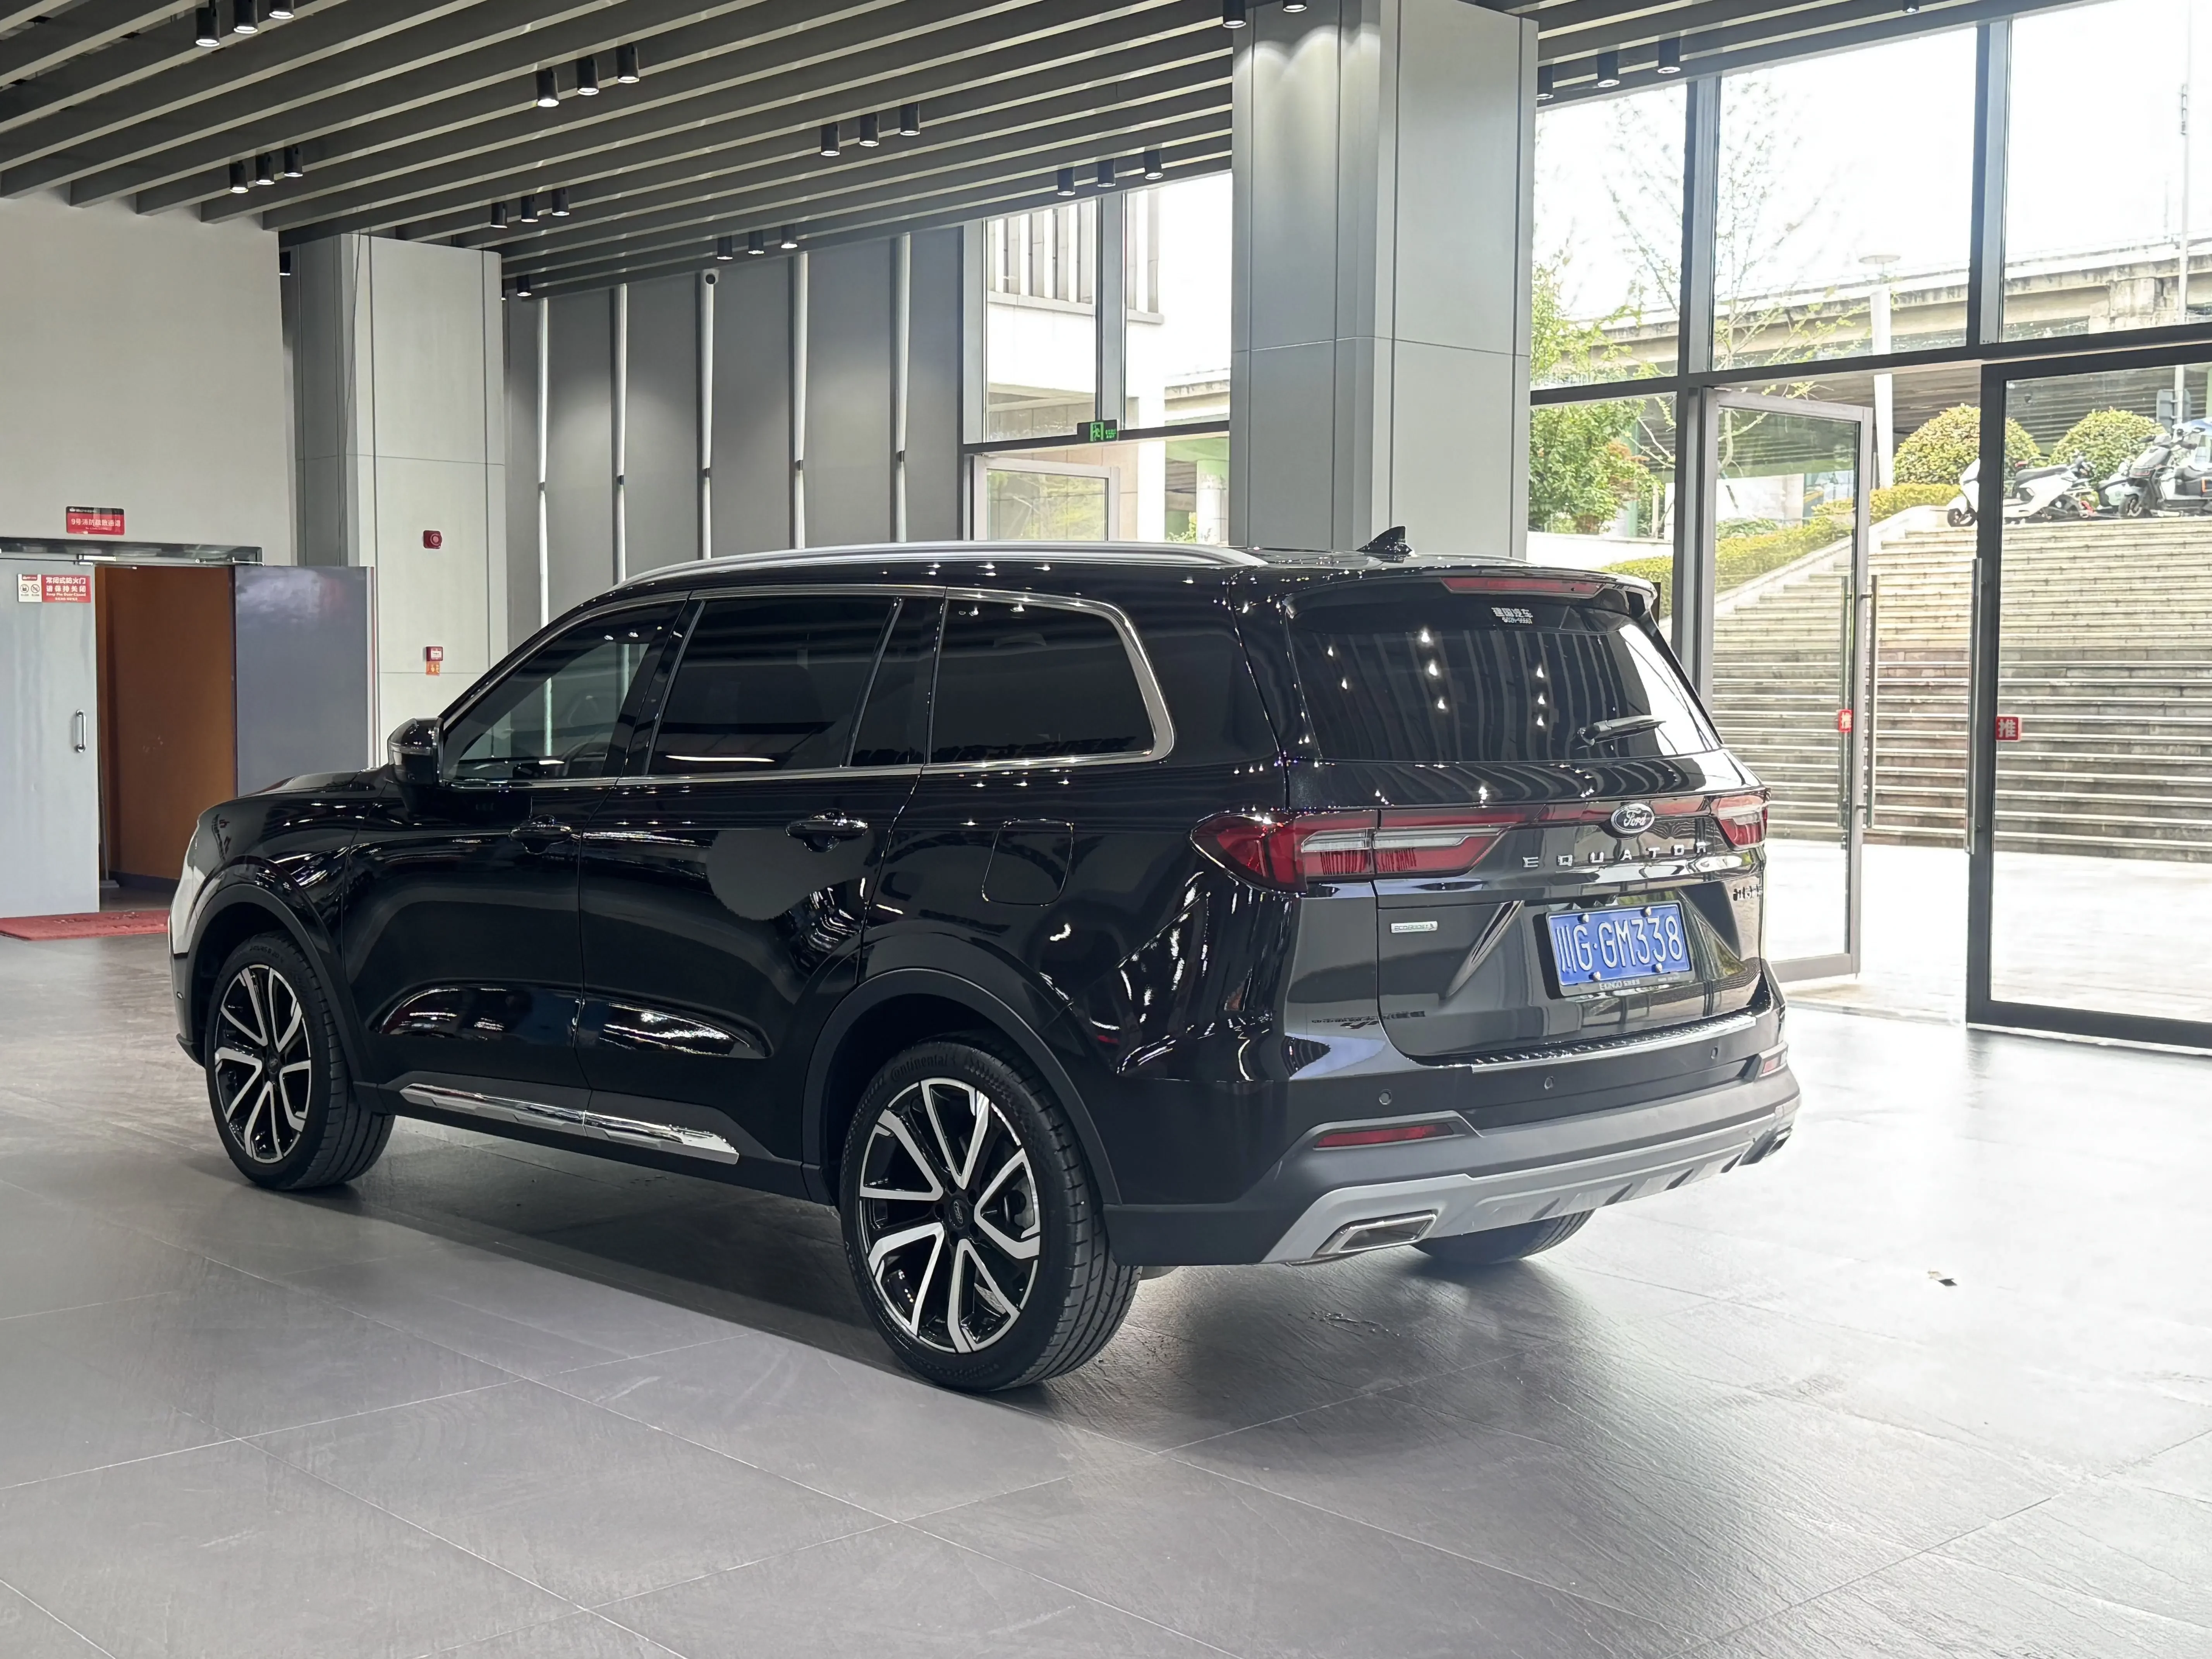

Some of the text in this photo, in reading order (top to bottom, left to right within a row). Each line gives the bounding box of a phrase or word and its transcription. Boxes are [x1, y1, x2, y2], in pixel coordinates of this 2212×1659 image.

[1491, 607, 1533, 618] 建国汽车
[1998, 718, 2016, 738] 推
[1623, 805, 1647, 827] Ford
[1523, 842, 1706, 867] EQUATOR
[891, 1053, 948, 1082] Continental
